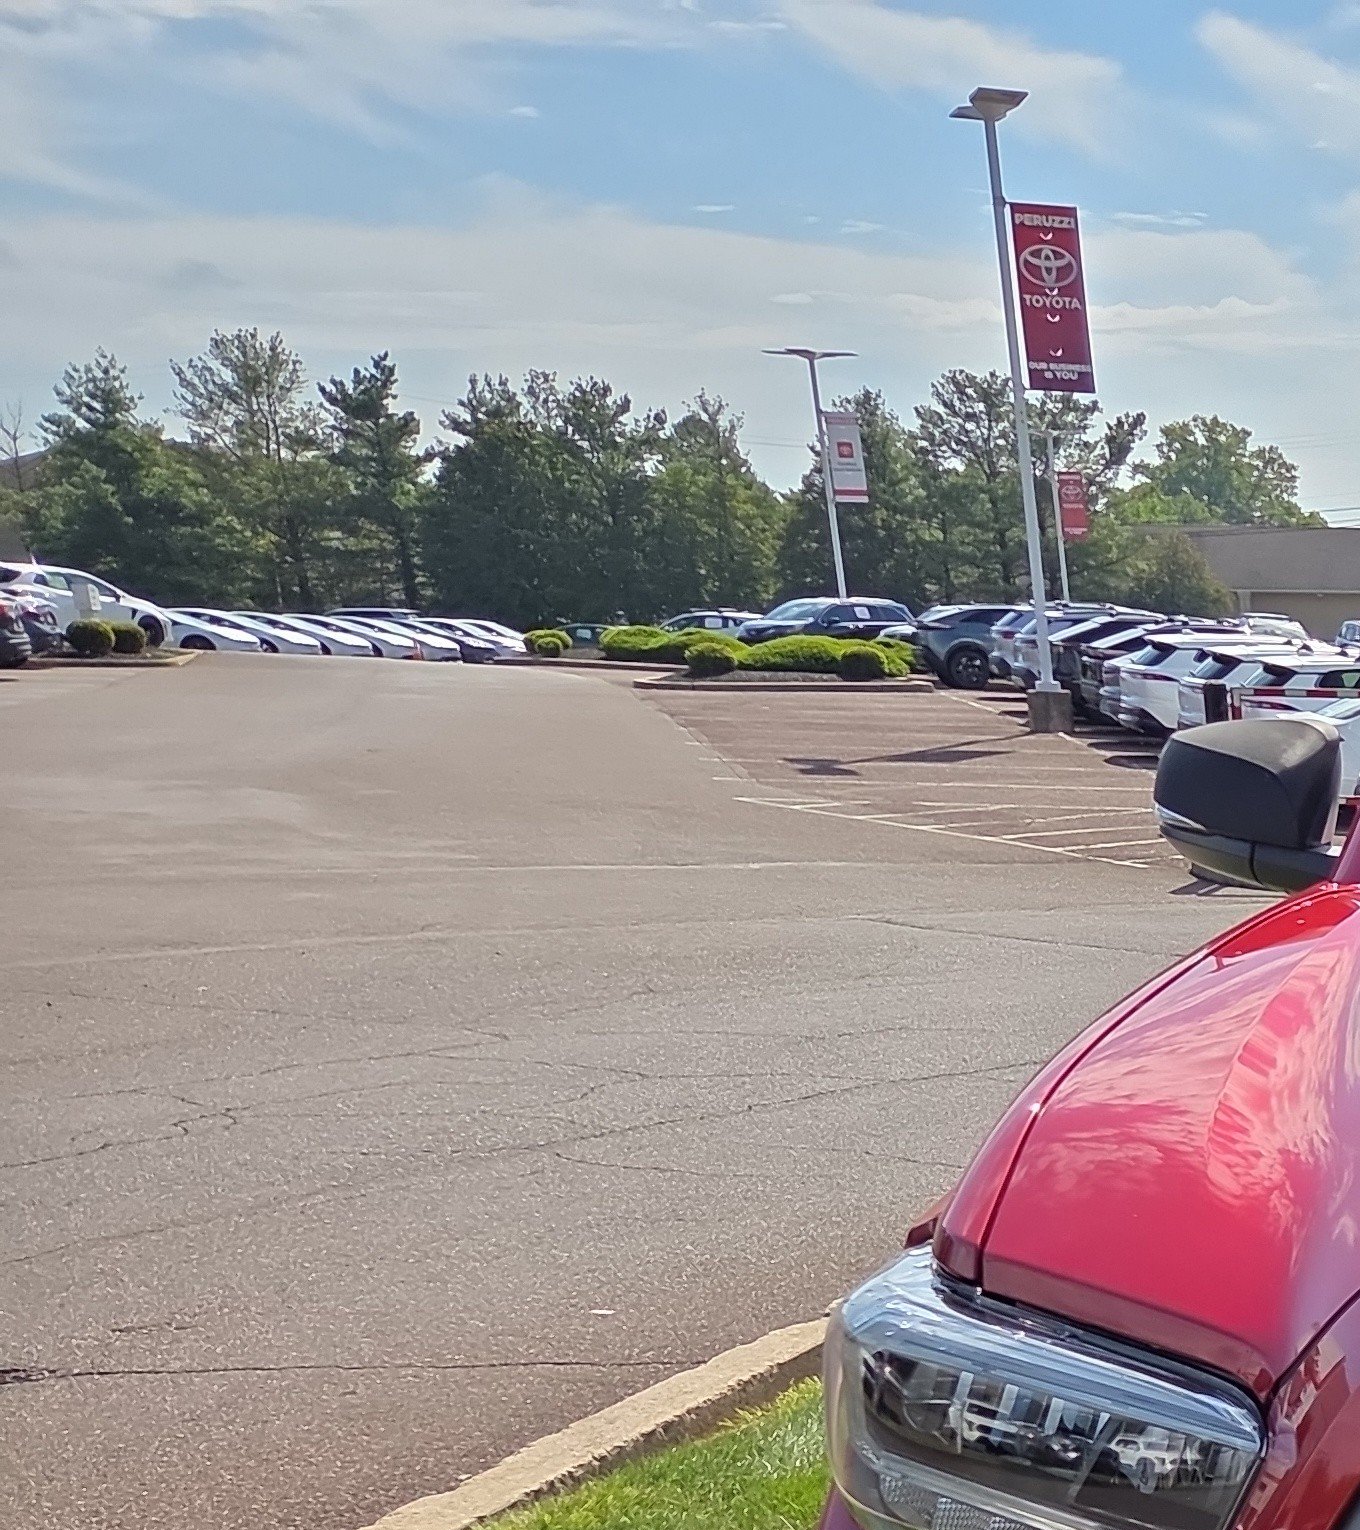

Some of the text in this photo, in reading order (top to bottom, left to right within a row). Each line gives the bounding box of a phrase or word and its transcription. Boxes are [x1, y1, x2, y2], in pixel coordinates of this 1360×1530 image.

[1014, 213, 1075, 229] PERUZZI
[1023, 294, 1082, 310] TOYOTA
[1055, 371, 1079, 380] YOU
